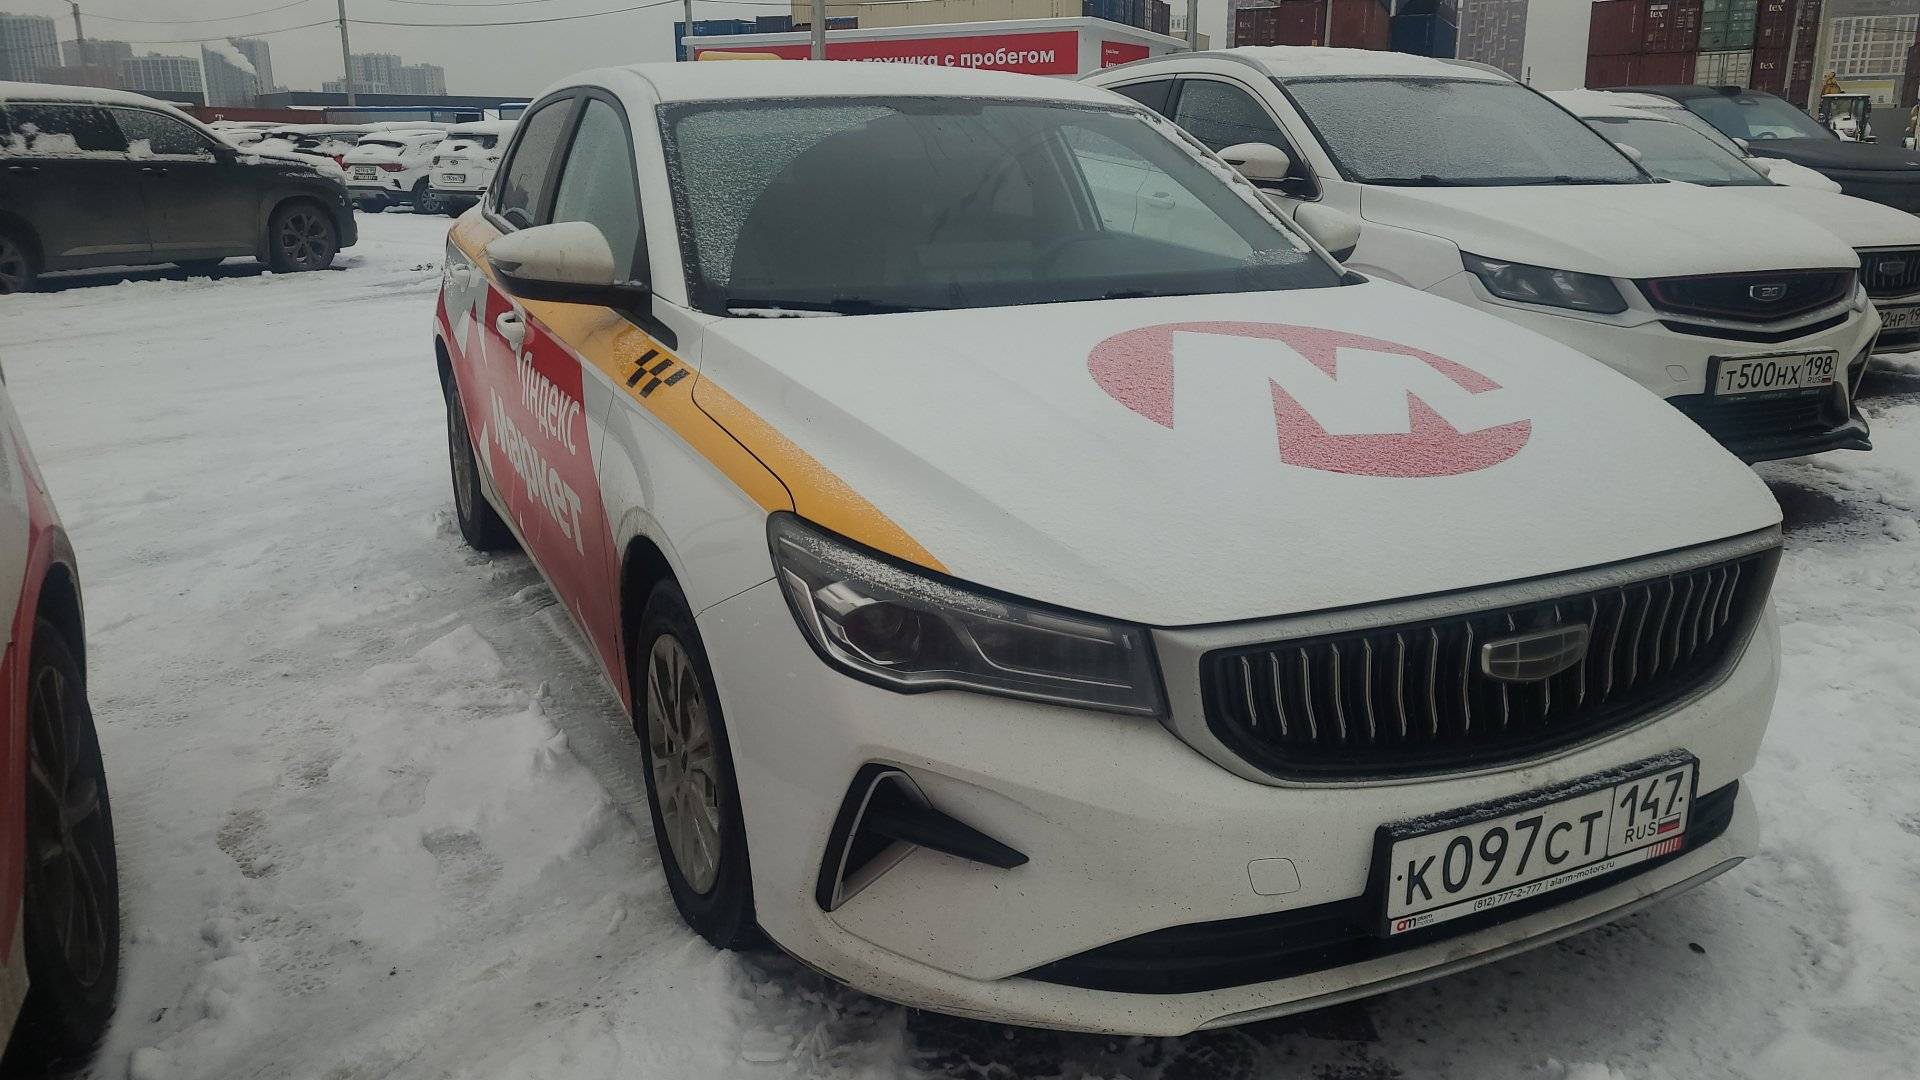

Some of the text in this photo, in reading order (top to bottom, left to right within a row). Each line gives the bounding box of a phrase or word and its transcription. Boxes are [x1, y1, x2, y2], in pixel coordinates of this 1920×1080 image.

[1650, 10, 1663, 18] tex
[1767, 4, 1783, 12] tex
[944, 54, 955, 66] с
[960, 47, 1055, 69] пробегом
[1806, 356, 1832, 376] 198
[521, 351, 580, 456] Яндекс
[490, 386, 584, 556] Маркет
[1620, 771, 1684, 827] 147
[1624, 821, 1657, 844] RUS
[1473, 861, 1615, 911] (812) 777-2-777 alarm-motors.ru
